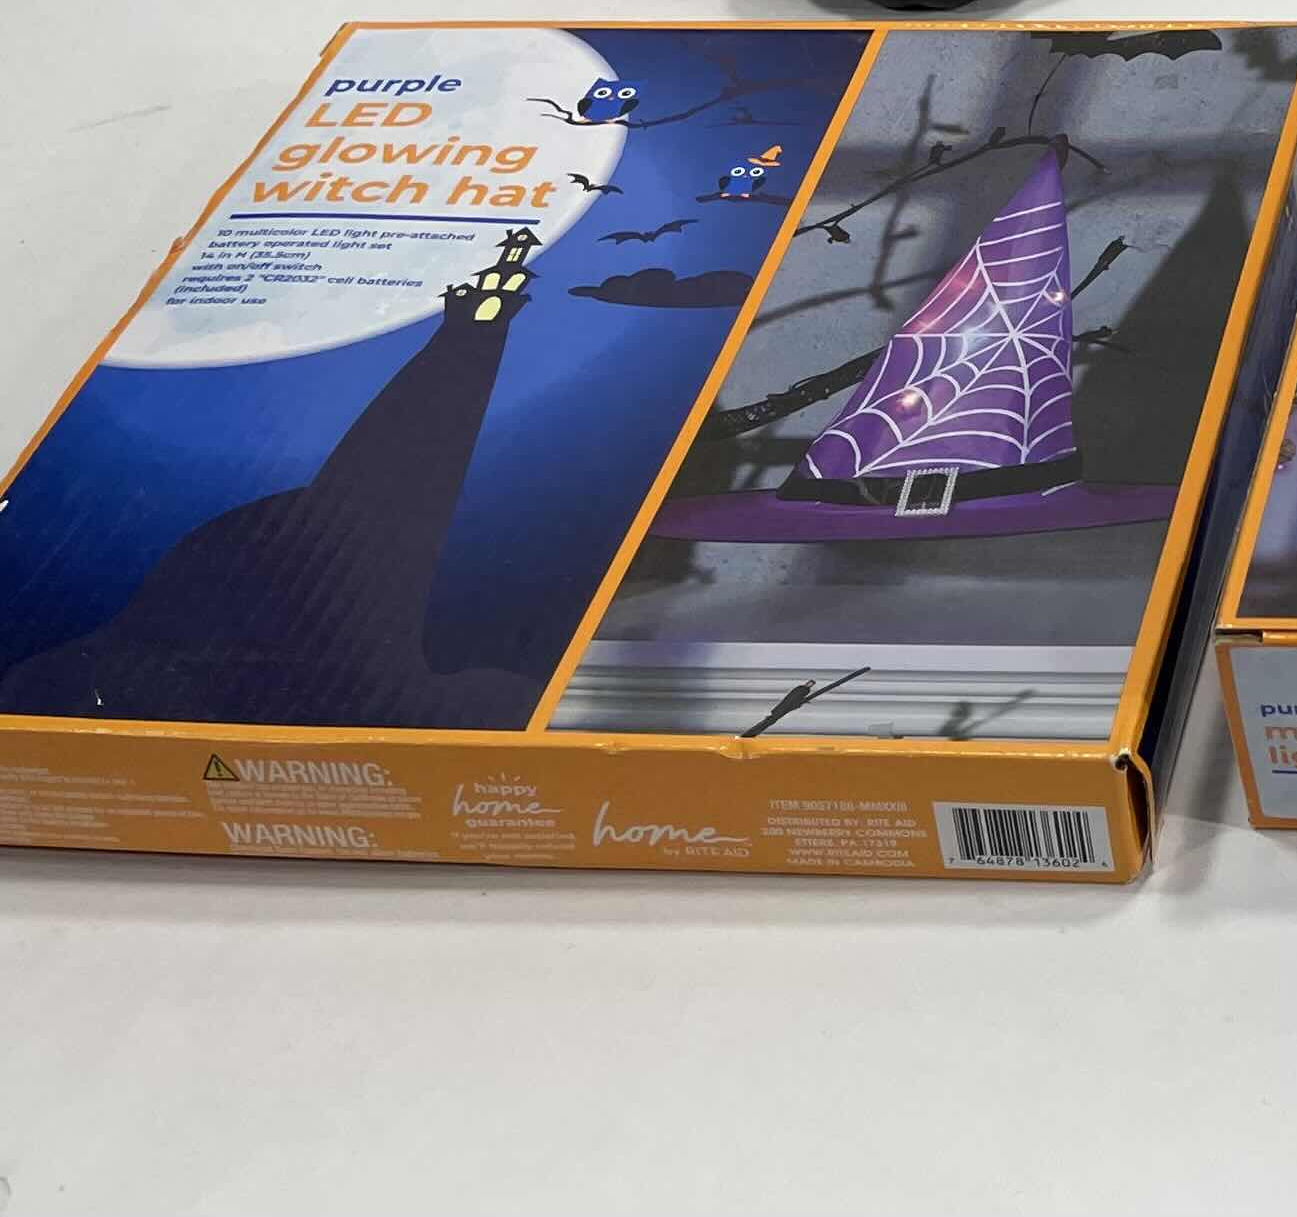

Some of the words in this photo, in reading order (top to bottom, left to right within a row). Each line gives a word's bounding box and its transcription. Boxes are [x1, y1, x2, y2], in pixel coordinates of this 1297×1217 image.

[325, 74, 461, 96] purple
[304, 102, 432, 128] LED
[271, 136, 539, 173] glowing
[250, 174, 430, 208] witch
[446, 177, 556, 210] hat
[343, 229, 377, 238] light
[379, 231, 475, 241] pre-attached
[208, 240, 261, 249] battery
[264, 240, 329, 249] operated
[332, 240, 367, 250] light
[369, 242, 392, 250] set
[192, 262, 224, 270] with
[273, 263, 322, 271] switch
[174, 284, 248, 294] (included)
[182, 275, 241, 283] requires
[357, 277, 424, 287] batteries
[166, 297, 185, 305] for
[189, 297, 237, 305] indoor
[233, 759, 393, 786] WARNING:
[474, 783, 537, 797] happy
[453, 783, 563, 816] home
[592, 799, 750, 847] home
[222, 822, 379, 848] WARNING:
[685, 846, 719, 856] RITE
